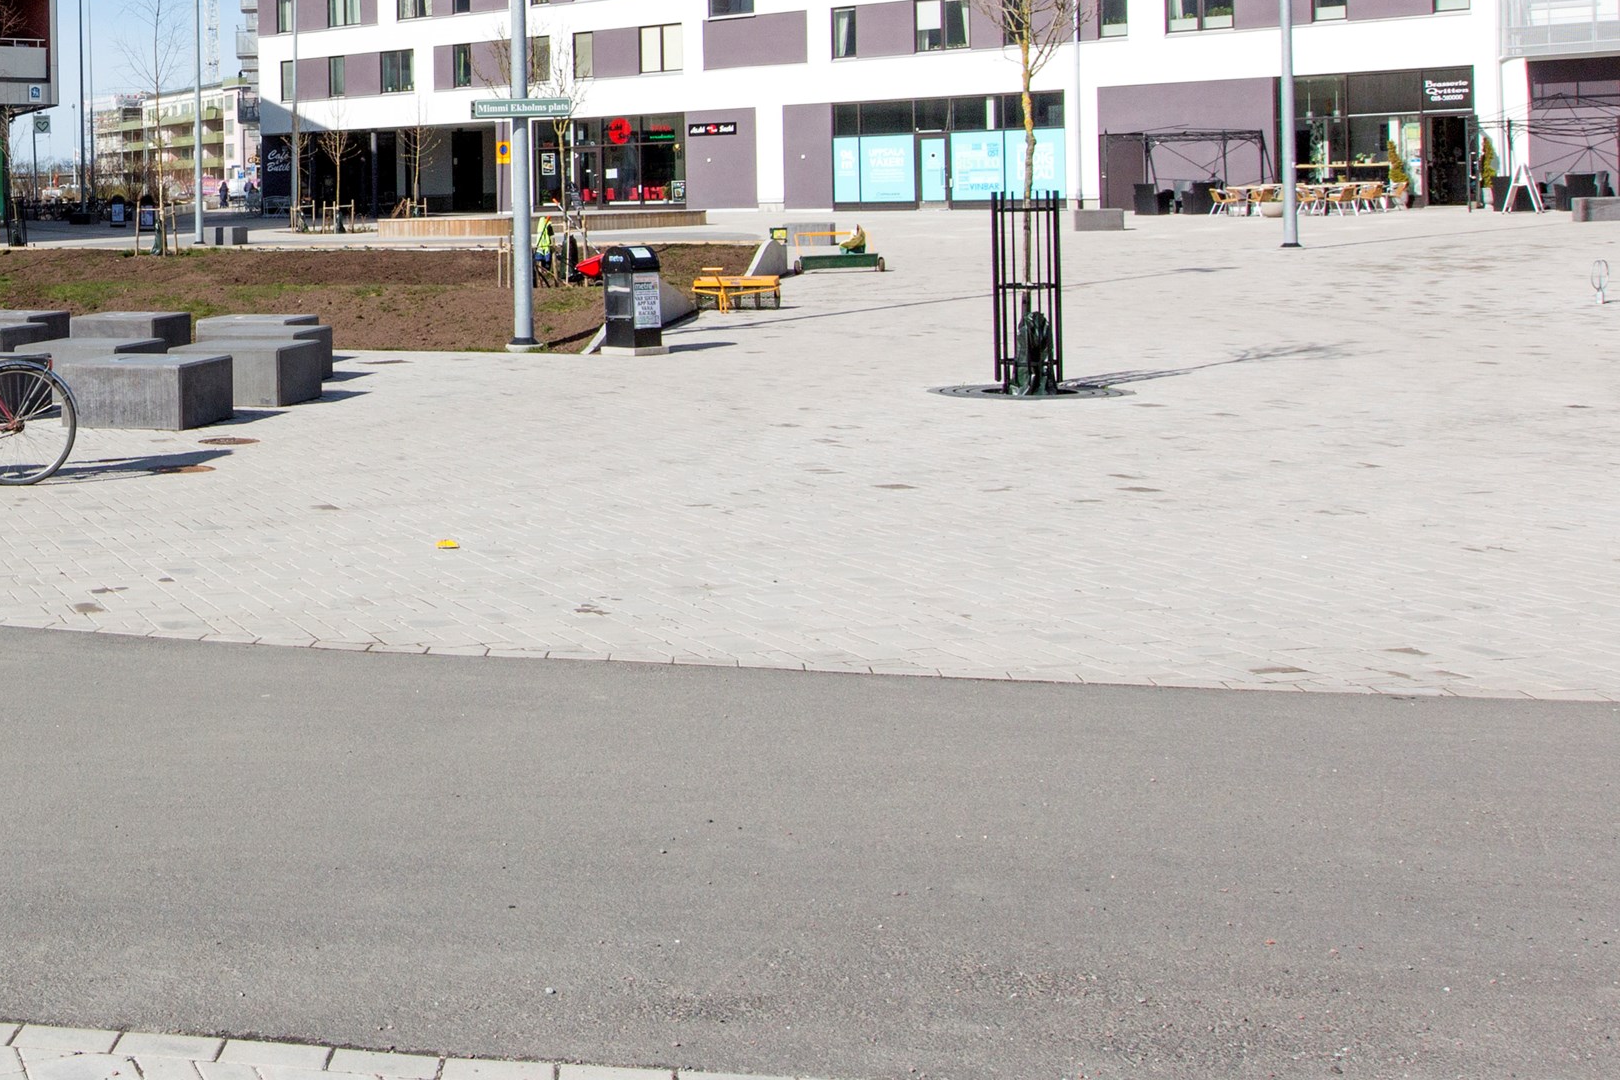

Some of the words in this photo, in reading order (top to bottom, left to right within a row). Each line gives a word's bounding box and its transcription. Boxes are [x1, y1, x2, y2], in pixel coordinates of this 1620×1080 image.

[1425, 87, 1469, 96] Qvitten
[478, 104, 509, 113] Mimmi
[510, 103, 547, 112] Ekholms
[548, 103, 569, 113] plats
[267, 162, 290, 172] Butik
[970, 183, 1000, 191] VINBAR
[634, 282, 652, 290] metro
